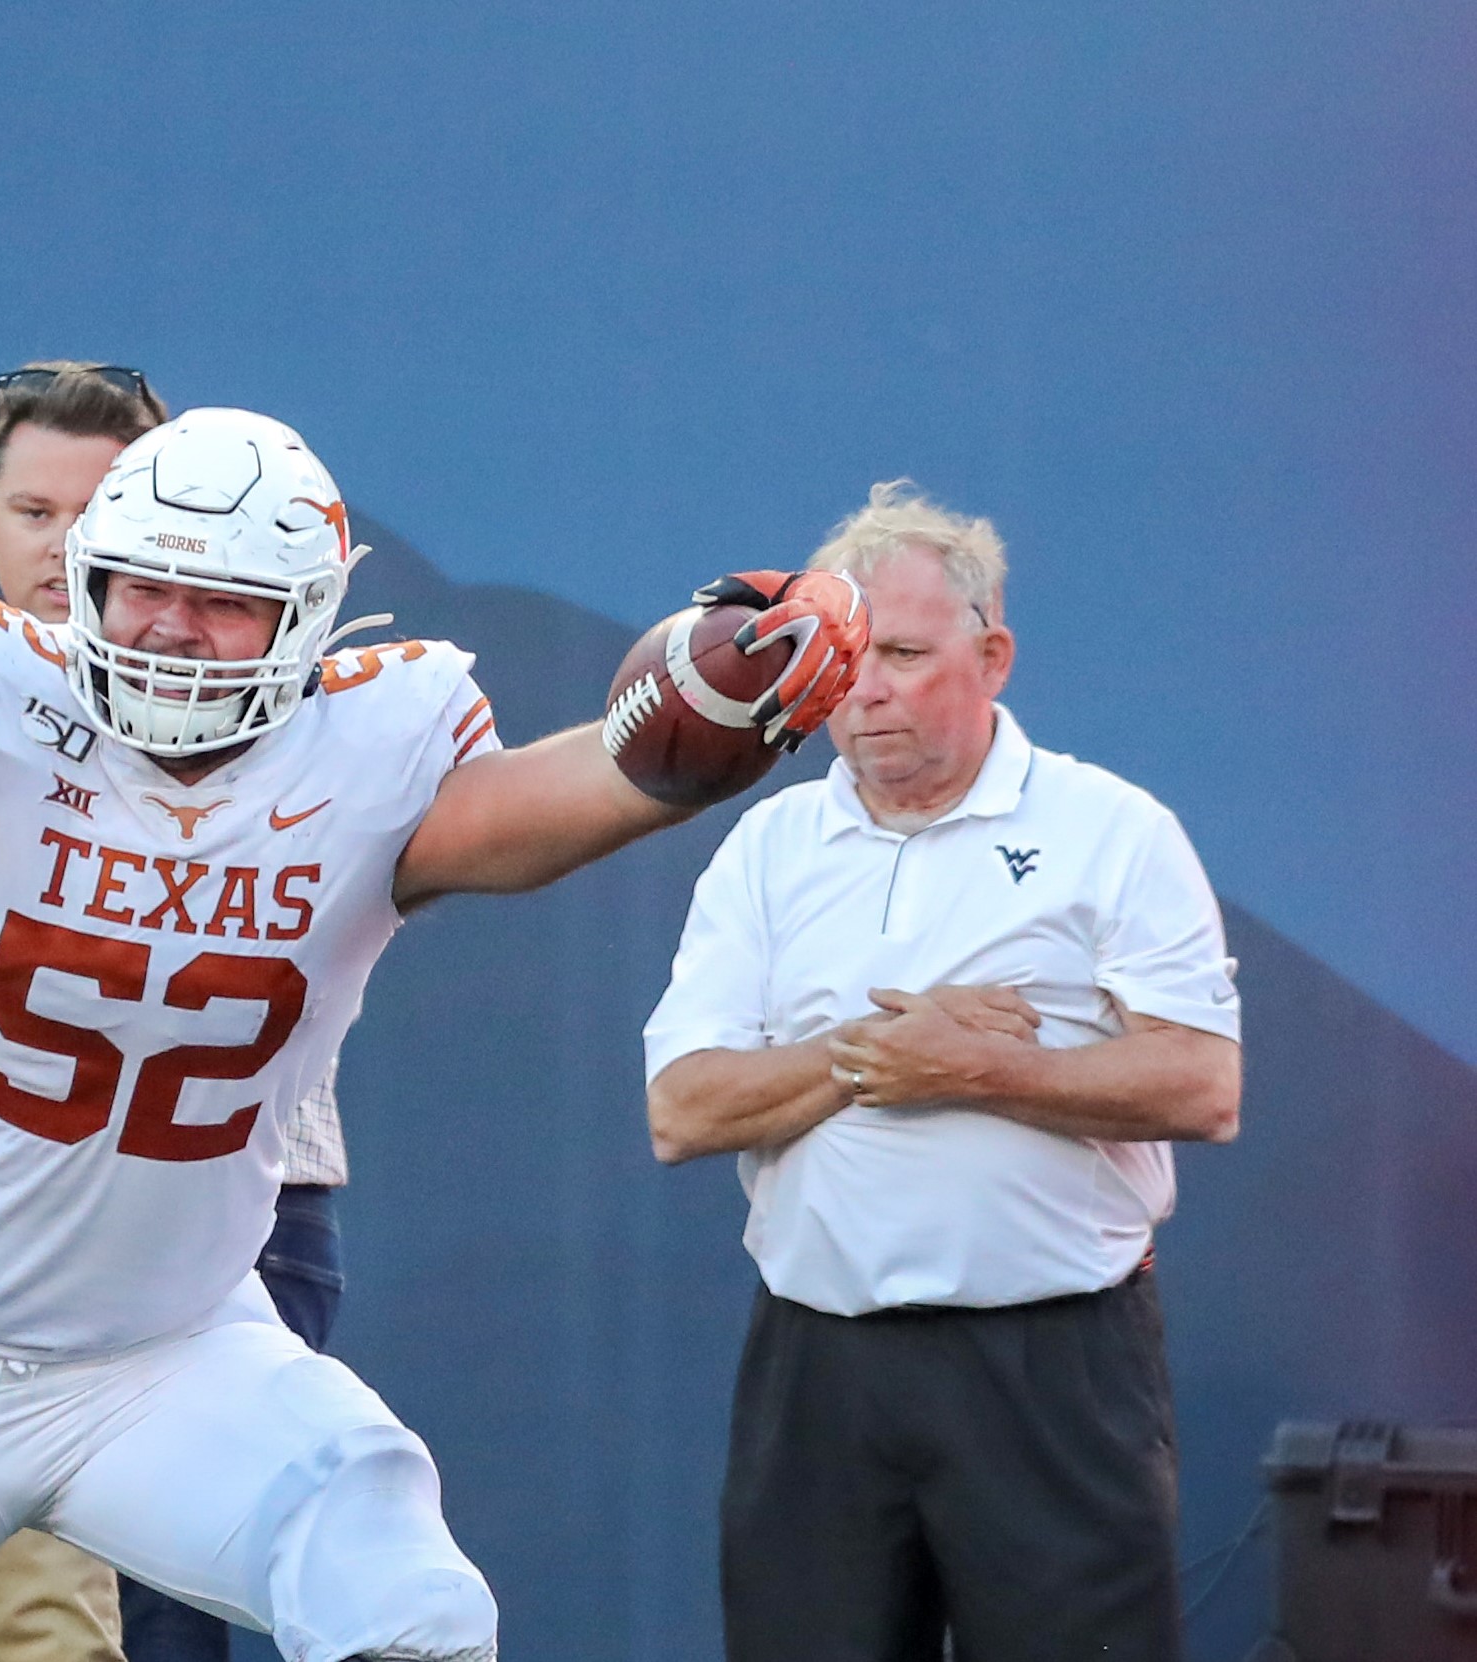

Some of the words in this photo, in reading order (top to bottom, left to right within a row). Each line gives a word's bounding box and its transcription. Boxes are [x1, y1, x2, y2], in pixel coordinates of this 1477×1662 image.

[156, 532, 207, 555] HORNS
[24, 697, 98, 763] 150
[44, 772, 100, 820] XII
[39, 827, 322, 941] TEXAS
